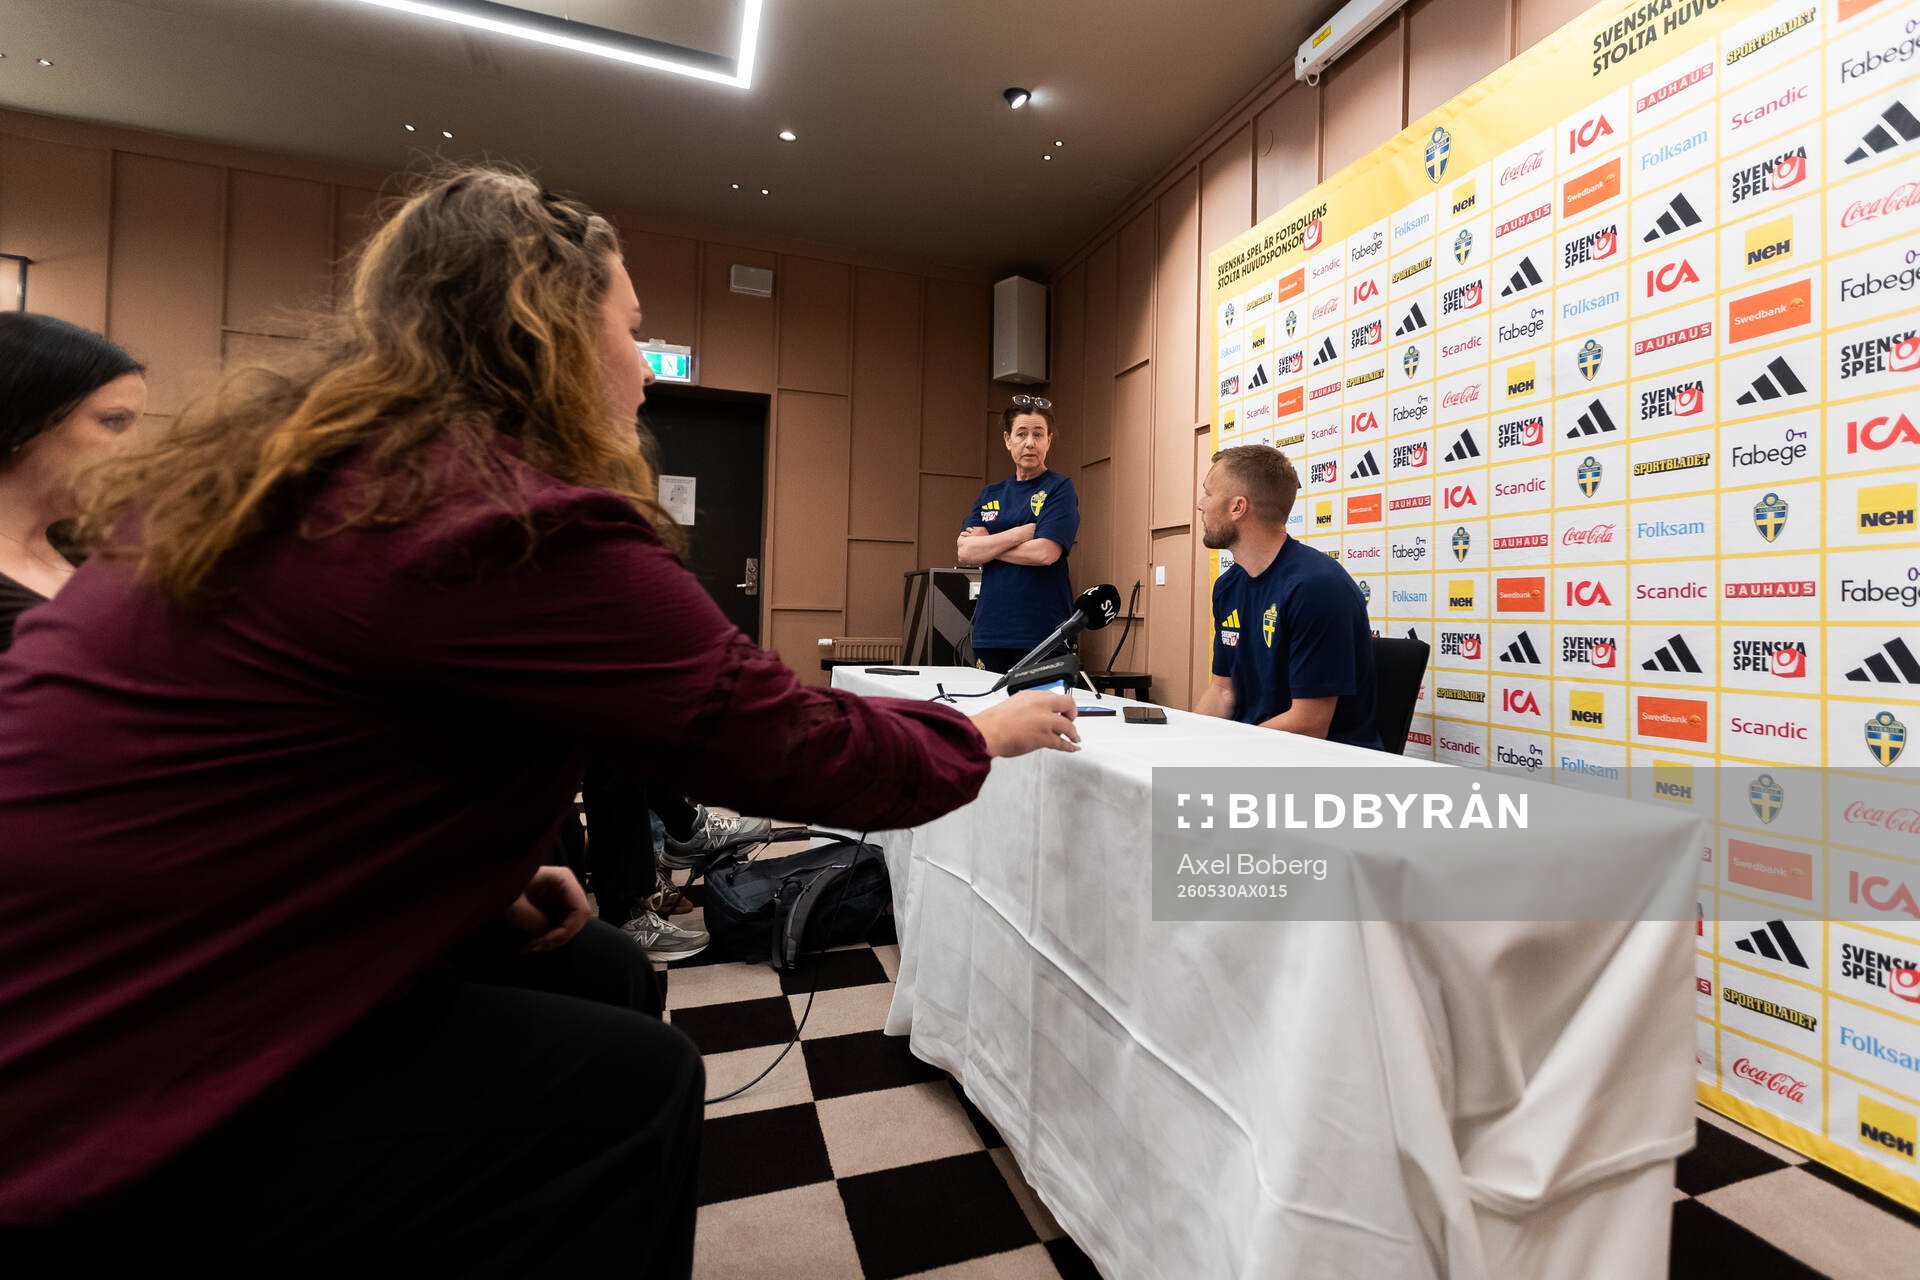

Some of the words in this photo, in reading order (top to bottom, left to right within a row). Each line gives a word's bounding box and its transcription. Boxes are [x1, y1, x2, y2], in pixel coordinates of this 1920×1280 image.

[1726, 8, 1816, 66] SPORTBLADET
[1593, 24, 1657, 76] STOLTA
[1637, 63, 1713, 113] BAUHAUS
[1731, 85, 1808, 131] Scandic
[1570, 115, 1614, 154] ICA
[1642, 130, 1708, 171] Folksam
[1732, 146, 1807, 189] SVENSKA
[1568, 181, 1603, 203] Swedbank
[1732, 180, 1769, 204] SPEL
[1394, 214, 1429, 239] Folksam
[1496, 204, 1550, 238] BAUHAUS
[1218, 252, 1244, 276] SVENSKA
[1247, 243, 1262, 260] SPEL
[1264, 236, 1273, 250] ÄR
[1276, 203, 1327, 244] FOTBOLLENS
[1565, 224, 1617, 256] SVENSKA
[1218, 270, 1240, 290] STOLTA
[1242, 232, 1304, 277] HUVUDSPONSOR
[1352, 240, 1382, 262] Fabege
[1565, 249, 1591, 269] SPEL
[1647, 259, 1700, 298] ICA
[1354, 279, 1379, 304] ICA
[1444, 280, 1482, 304] SVENSKA
[1443, 298, 1463, 315] SPEL
[1563, 291, 1620, 319] Folksam
[1734, 304, 1787, 326] Swedbank
[1499, 319, 1544, 343] Fabege
[1635, 322, 1711, 356] BAUHAUS
[1352, 336, 1367, 349] SPEL
[1442, 336, 1482, 358] Scandic
[1279, 365, 1291, 376] SPEL
[1841, 358, 1885, 379] SPEL
[1641, 380, 1704, 407] SVENSKA
[1393, 404, 1427, 422] Fabege
[1641, 402, 1672, 420] SPEL
[1312, 424, 1338, 440] Scandic
[1352, 411, 1378, 434] ICA
[1499, 416, 1543, 436] SVENSKA
[1847, 413, 1920, 454] ICA
[1393, 442, 1427, 458] SVENSKA
[1499, 434, 1521, 448] SPEL
[1393, 456, 1410, 468] SPEL
[1634, 454, 1710, 476] SPORTBLADET
[1732, 444, 1806, 467] Fabege
[1311, 460, 1337, 475] SVENSKA
[1311, 472, 1324, 484] SPEL
[1444, 485, 1477, 509] ICA
[1496, 478, 1546, 496] Scandic
[1390, 496, 1431, 511] BAUHAUS
[1563, 524, 1616, 546] Coca-Cola
[1638, 522, 1704, 538] Folksam
[1348, 547, 1380, 559] Scandic
[1392, 545, 1425, 561] Fabege
[1494, 534, 1548, 550] BAUHAUS
[1392, 590, 1427, 602] Folksam
[1567, 581, 1612, 606] ICA
[1636, 583, 1707, 599] Scandic
[1726, 582, 1815, 598] BAUHAUS
[1842, 579, 1920, 607] Fabeg
[1441, 633, 1481, 645] SVENSKA
[1441, 643, 1461, 655] SPEL
[1563, 637, 1616, 650] SVENSKA
[1734, 641, 1807, 657] SVENSKA
[1563, 649, 1590, 663] SPEL
[1734, 656, 1768, 672] SPEL
[1503, 688, 1541, 716] ICA
[1642, 713, 1687, 724] Swedbank
[1731, 718, 1807, 739] Scandic
[1440, 738, 1480, 755] Scandic
[1498, 746, 1542, 772] Fabege
[1561, 756, 1618, 780] Folksam
[1734, 857, 1786, 876] Swedbank
[1849, 871, 1920, 919] ICA
[1842, 961, 1886, 988] SPEL
[1724, 988, 1816, 1032] SPORTBLADET
[1733, 1058, 1807, 1104] Coca-Cola
